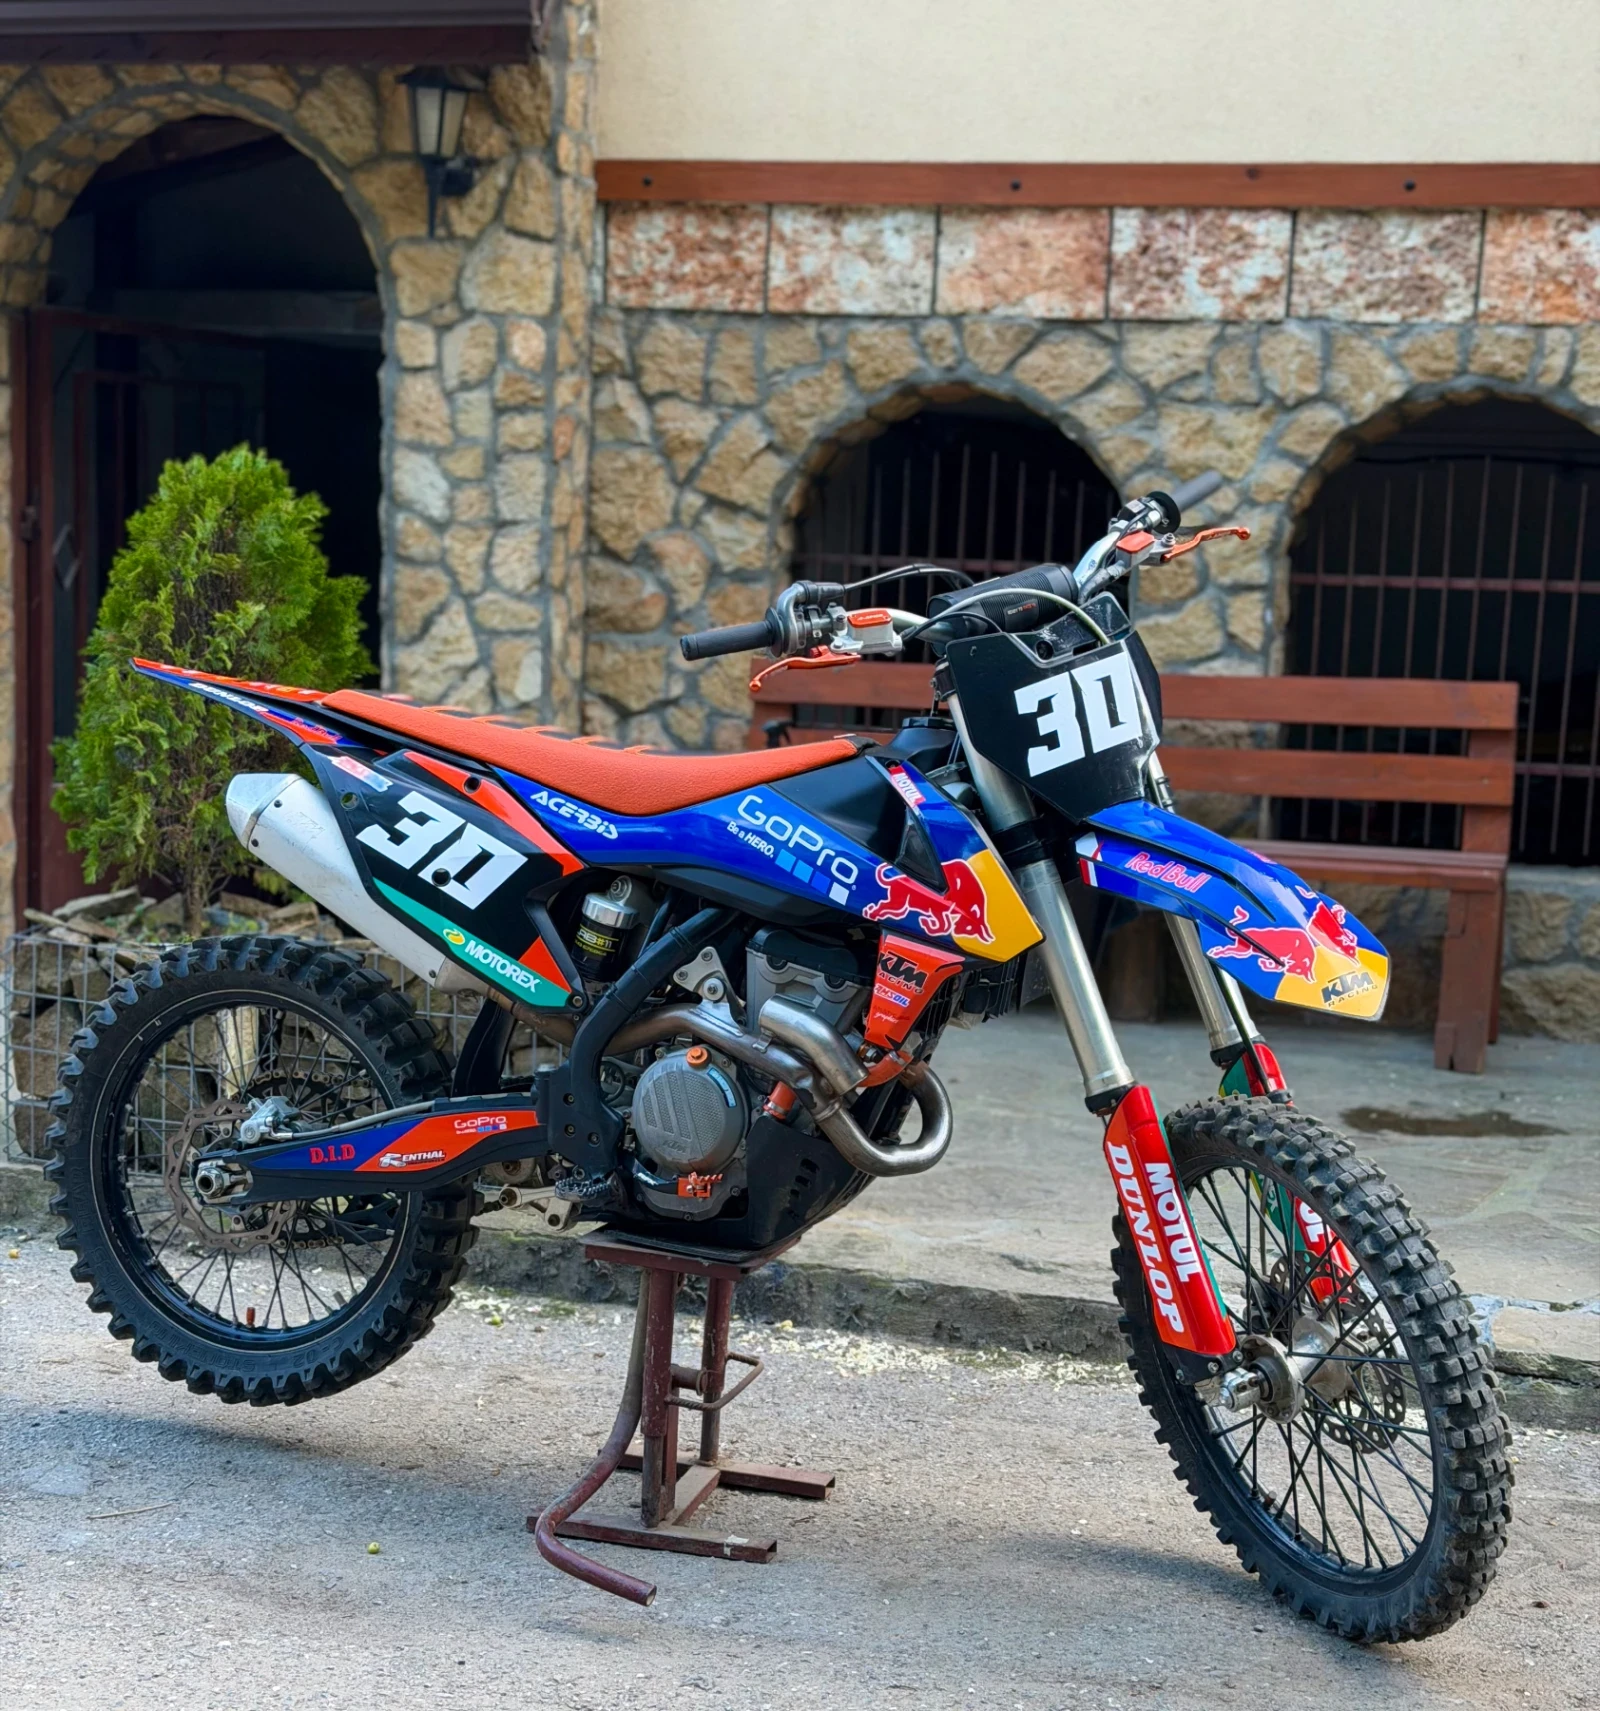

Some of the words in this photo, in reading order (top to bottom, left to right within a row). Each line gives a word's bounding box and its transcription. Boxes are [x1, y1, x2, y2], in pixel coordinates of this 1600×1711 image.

[1014, 651, 1143, 777] 30
[892, 772, 923, 807] MOTUL
[355, 790, 529, 910] 30
[727, 821, 739, 835] Be
[737, 795, 859, 885] GoPro
[464, 940, 541, 993] MOTOREX
[878, 971, 925, 994] ACING
[1321, 971, 1374, 1004] KTM
[1328, 984, 1378, 1007] RACING
[454, 1115, 507, 1129] GoPro
[1106, 1141, 1185, 1334] DUNLOP
[1145, 1162, 1202, 1283] MOTUL
